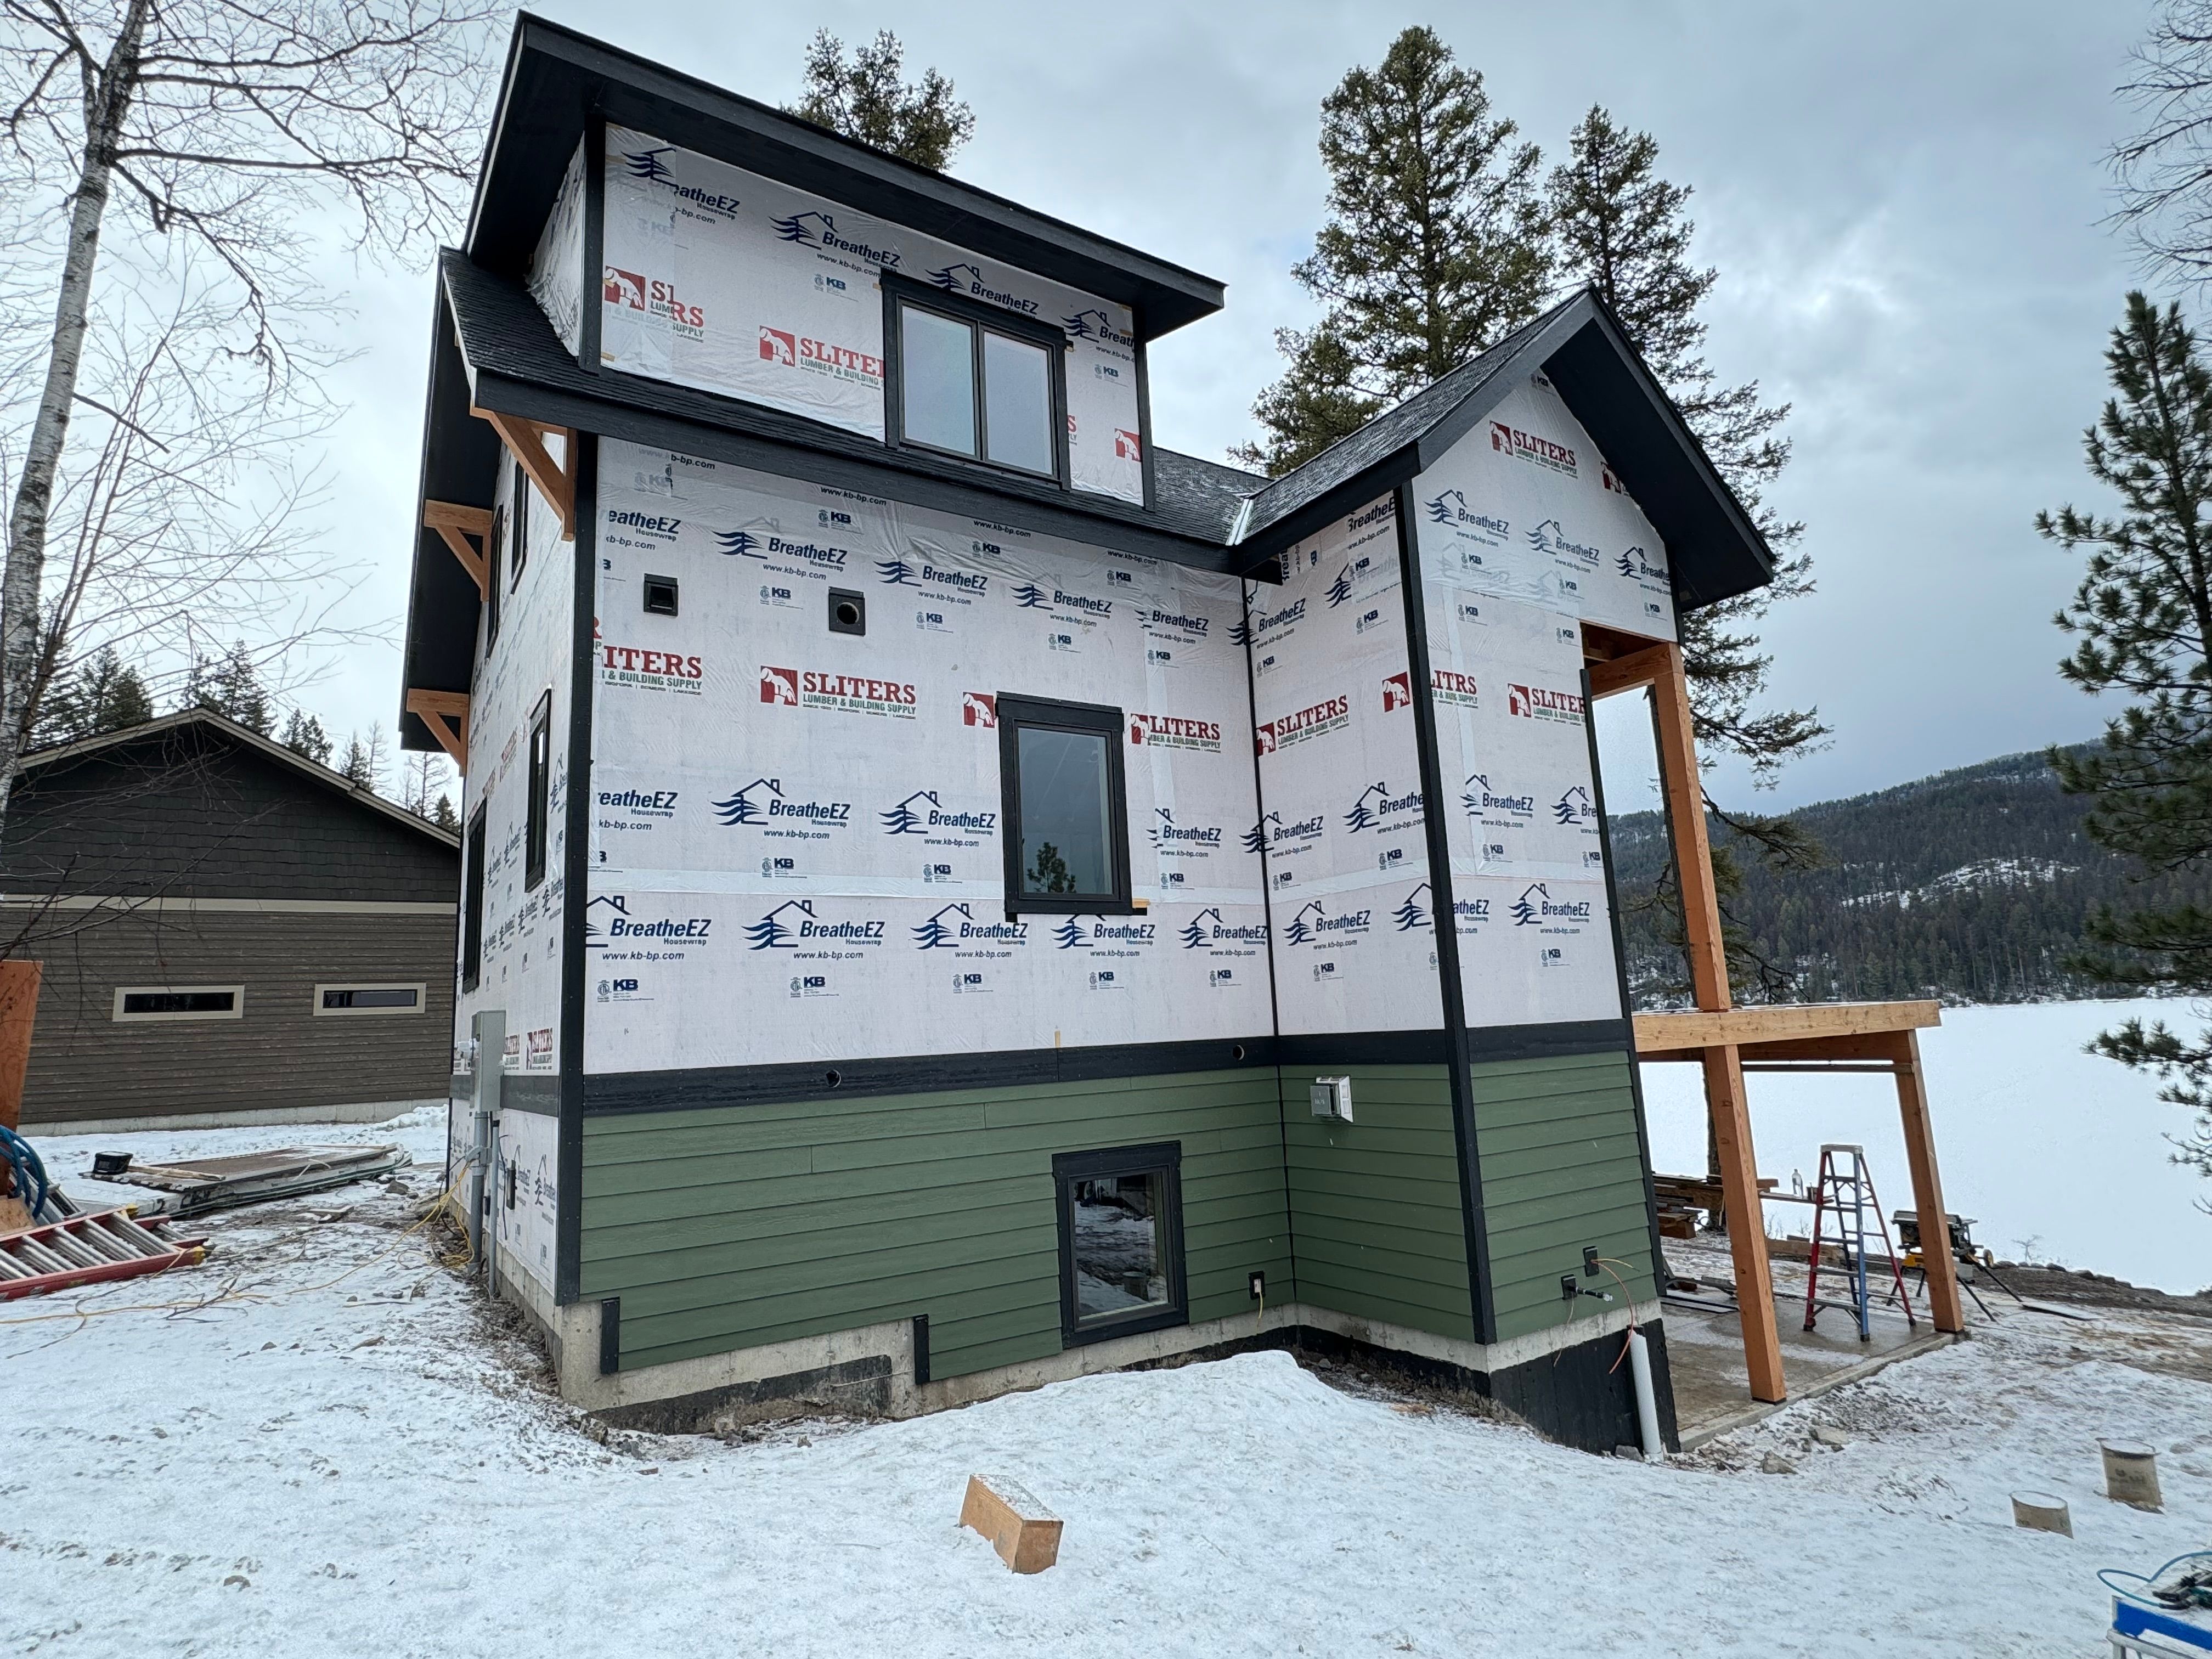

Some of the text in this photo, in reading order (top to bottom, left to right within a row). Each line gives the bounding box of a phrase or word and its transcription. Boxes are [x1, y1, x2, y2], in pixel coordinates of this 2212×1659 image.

[675, 185, 740, 214] atheEZ
[822, 230, 901, 268] BreatheEZ
[826, 276, 846, 291] KB
[971, 281, 1039, 315] BreatheEZ
[800, 337, 884, 378] SLITE
[800, 357, 833, 372] LUMBER
[836, 368, 842, 376] &
[844, 369, 879, 385] BUILDING
[1103, 365, 1119, 377] KB
[1513, 429, 1576, 467] SLITERS
[820, 486, 887, 506] www.kb-bp.com
[608, 510, 682, 535] eatheEZ
[831, 511, 851, 524] KB
[1458, 507, 1509, 534] BreatheEZ
[635, 527, 677, 542] Housewrap
[974, 519, 1031, 538] www.kb-bp.com
[768, 537, 848, 565] BreatheEZ
[982, 543, 1001, 555] KB
[1556, 537, 1599, 561] BreatheEZ
[1355, 557, 1370, 571] KB
[1469, 554, 1482, 565] KB
[763, 563, 826, 580] www.kb-bp.com
[922, 565, 988, 590] BreatheEZ
[1115, 571, 1132, 582] KB
[771, 586, 792, 599] KB
[1565, 580, 1577, 591] KB
[918, 590, 972, 606] www.kb-bp.com
[1053, 590, 1113, 613] BreatheEZ
[926, 612, 943, 624] KB
[1259, 597, 1306, 633] BreatheEZ
[1364, 609, 1379, 624] KB
[1465, 605, 1479, 617] KB
[1049, 613, 1097, 628] www.kb-bp.com
[1152, 610, 1209, 632] BreatheEZ
[1058, 634, 1072, 645] KB
[1149, 631, 1196, 644] www.kb-bp.com
[1562, 629, 1575, 639] KB
[603, 645, 703, 679] ITERS
[1155, 650, 1171, 661] KB
[1263, 655, 1275, 667] KB
[608, 670, 703, 690] & BUILDING SUPPLY
[803, 671, 916, 705] SLITERS
[803, 693, 917, 715] LUMBER & BUILDING SUPPLY
[1532, 688, 1585, 714] SLITER
[1277, 694, 1348, 737] SLITERS
[1149, 715, 1221, 741] LITERS
[597, 789, 679, 810] eatheEZ
[1379, 791, 1424, 815] Breathe
[1482, 792, 1534, 811] BreatheEZ
[631, 808, 674, 819] Housewrap
[768, 799, 851, 820] BreatheEZ
[928, 809, 996, 829] BreatheEZ
[763, 829, 830, 840] www.kb-bp.com
[1163, 825, 1222, 842] BreatheEZ
[1273, 815, 1324, 842] BreatheEZ
[924, 837, 979, 848] www.kb-bp.com
[1490, 844, 1504, 855] KB
[1160, 849, 1209, 859] www.kb-bp.com
[1386, 849, 1402, 861] KB
[1589, 851, 1601, 861] KB
[774, 857, 794, 869] KB
[934, 864, 951, 875] KB
[1169, 872, 1184, 883] KB
[1279, 871, 1293, 882] KB
[1453, 899, 1489, 915] atheEZ
[1541, 900, 1590, 916] BreatheEZ
[610, 918, 712, 938] BreatheEZ
[1316, 910, 1371, 932] BreatheEZ
[799, 920, 885, 939] BreatheEZ
[960, 921, 1028, 939] BreatheEZ
[1093, 923, 1155, 939] BreatheEZ
[1212, 924, 1268, 939] BreatheEZ
[664, 938, 707, 947] Housewrap
[845, 938, 882, 946] Housewrap
[602, 951, 685, 962] www.kb-bp.com
[793, 950, 864, 961] www.kb-bp.com
[955, 950, 1012, 960] www.kb-bp.com
[1090, 949, 1140, 958] www.kb-bp.com
[1548, 949, 1561, 959] KB
[1217, 969, 1232, 979] KB
[1321, 962, 1334, 973] KB
[803, 976, 826, 988] KB
[963, 973, 983, 984] KB
[1098, 971, 1114, 981] KB
[613, 979, 639, 992] KB
